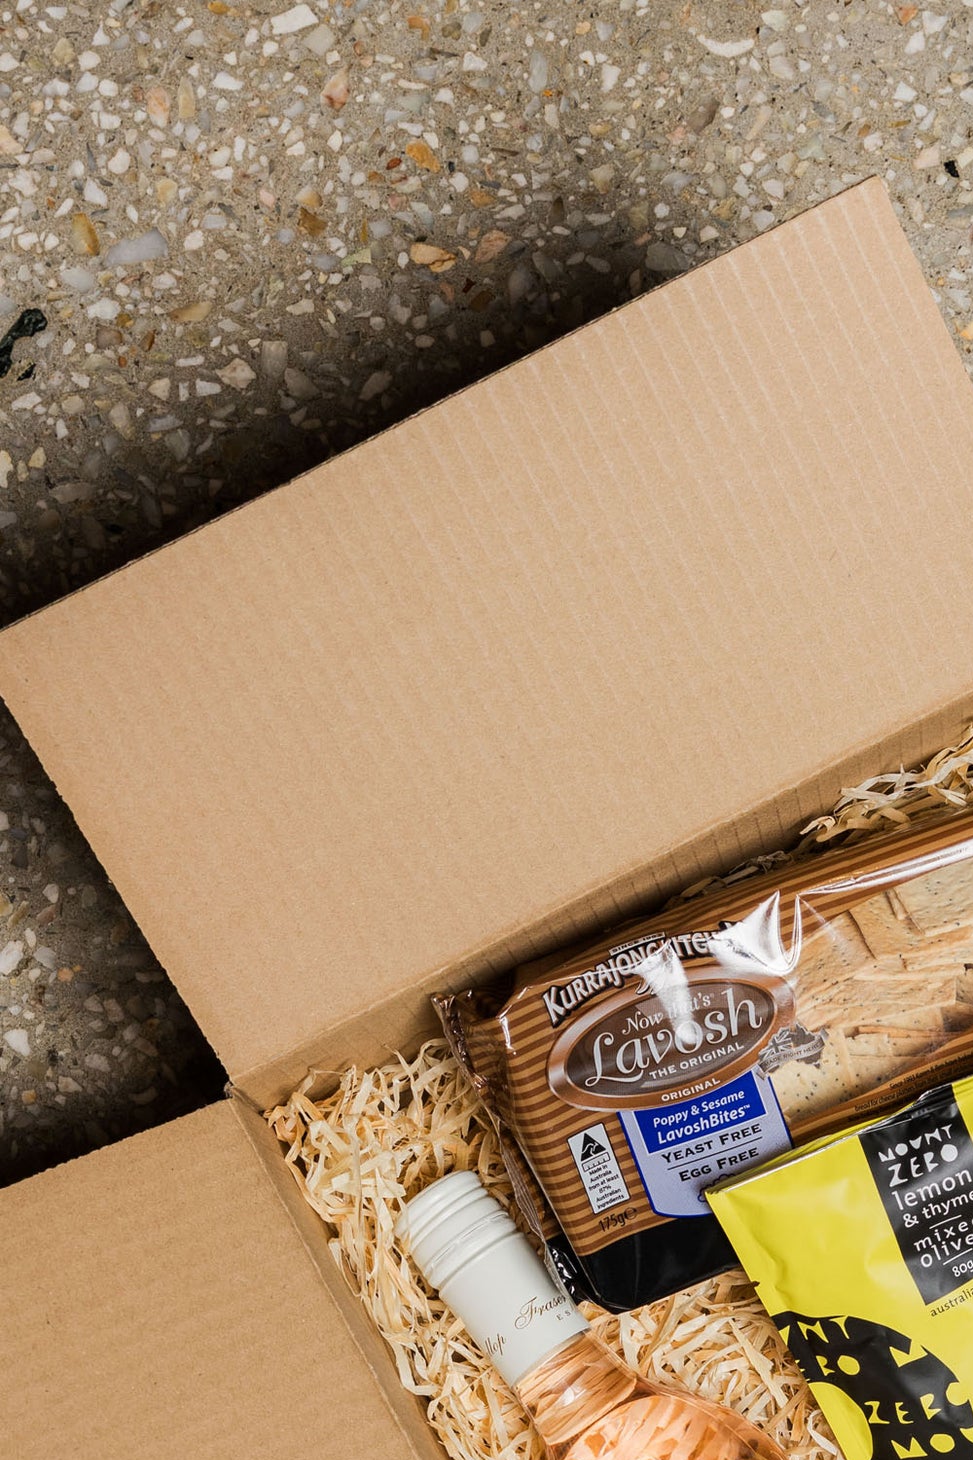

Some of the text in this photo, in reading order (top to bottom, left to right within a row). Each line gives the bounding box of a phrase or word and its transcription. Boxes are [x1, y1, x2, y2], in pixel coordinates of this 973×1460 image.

[543, 941, 660, 1025] KURRAJONG
[585, 987, 763, 1087] Lavosh
[622, 1011, 663, 1035] Now
[649, 1042, 745, 1081] THE ORIGINAL
[661, 1077, 721, 1102] ORIGINAL
[653, 1090, 745, 1128] Poppy & Sesame
[661, 1123, 762, 1164] YEAST FREE
[878, 1124, 953, 1162] MOUNT
[588, 1183, 600, 1191] from
[606, 1174, 619, 1182] least
[589, 1167, 602, 1176] Made
[590, 1170, 612, 1183] Australia
[679, 1147, 760, 1182] EGG FREE
[888, 1143, 959, 1188] ZERO
[597, 1188, 621, 1202] Australian
[892, 1169, 973, 1210] lemon
[903, 1213, 919, 1229] &
